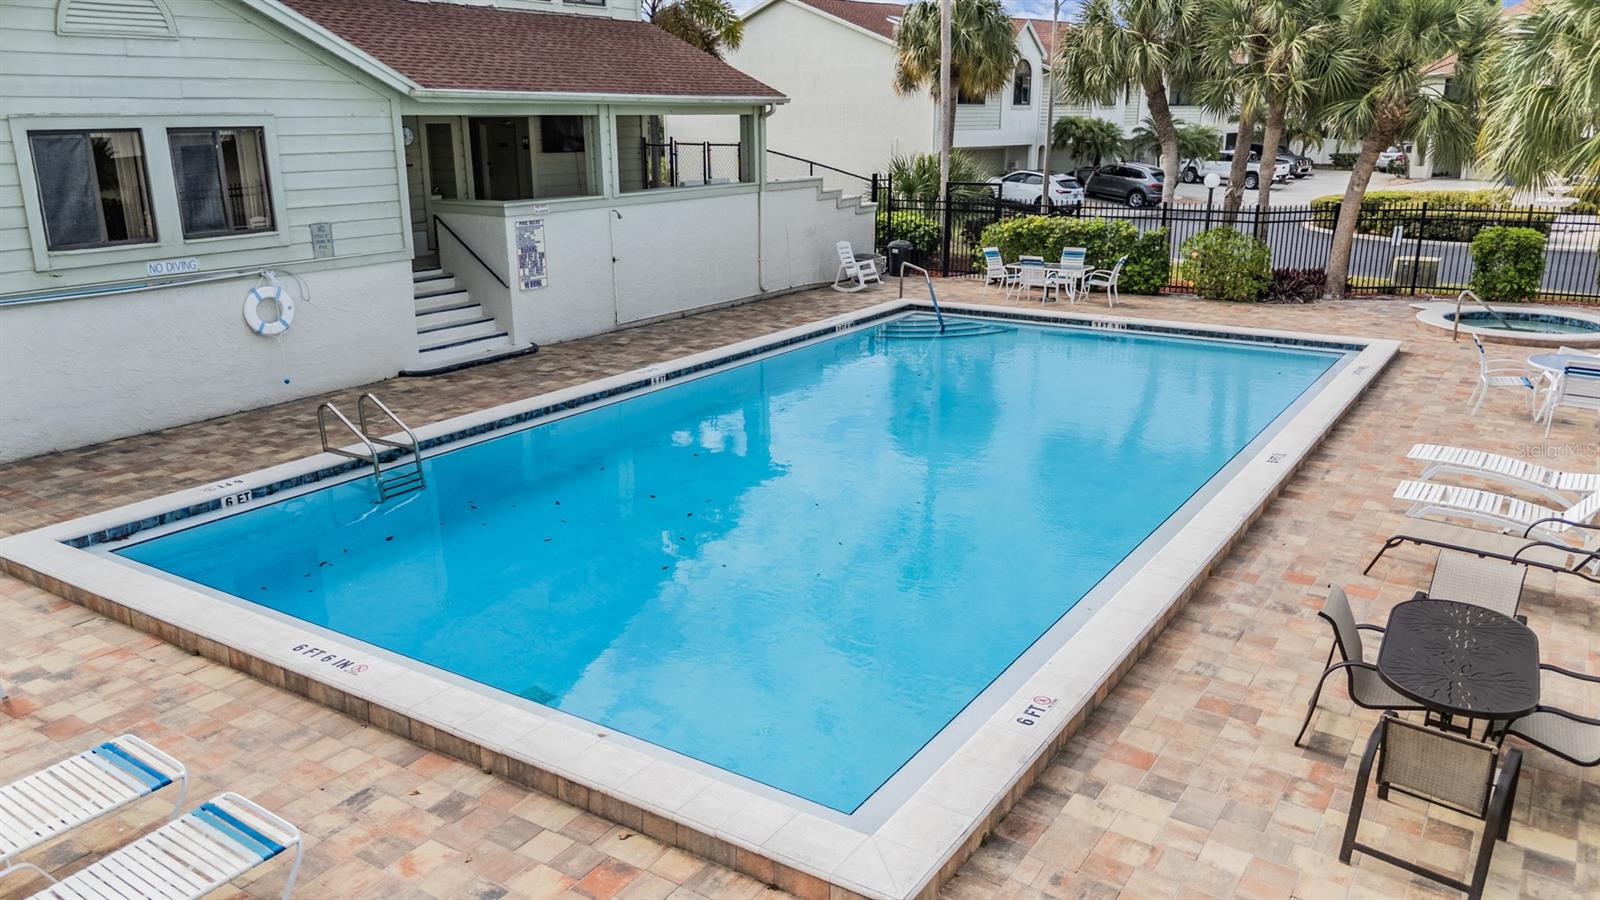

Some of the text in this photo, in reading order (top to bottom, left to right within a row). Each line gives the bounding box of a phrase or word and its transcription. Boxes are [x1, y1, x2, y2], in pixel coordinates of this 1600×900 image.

[149, 259, 197, 274] NO DIVING
[292, 643, 355, 669] 6 FT 6 IN
[1016, 704, 1046, 726] 6 FT
